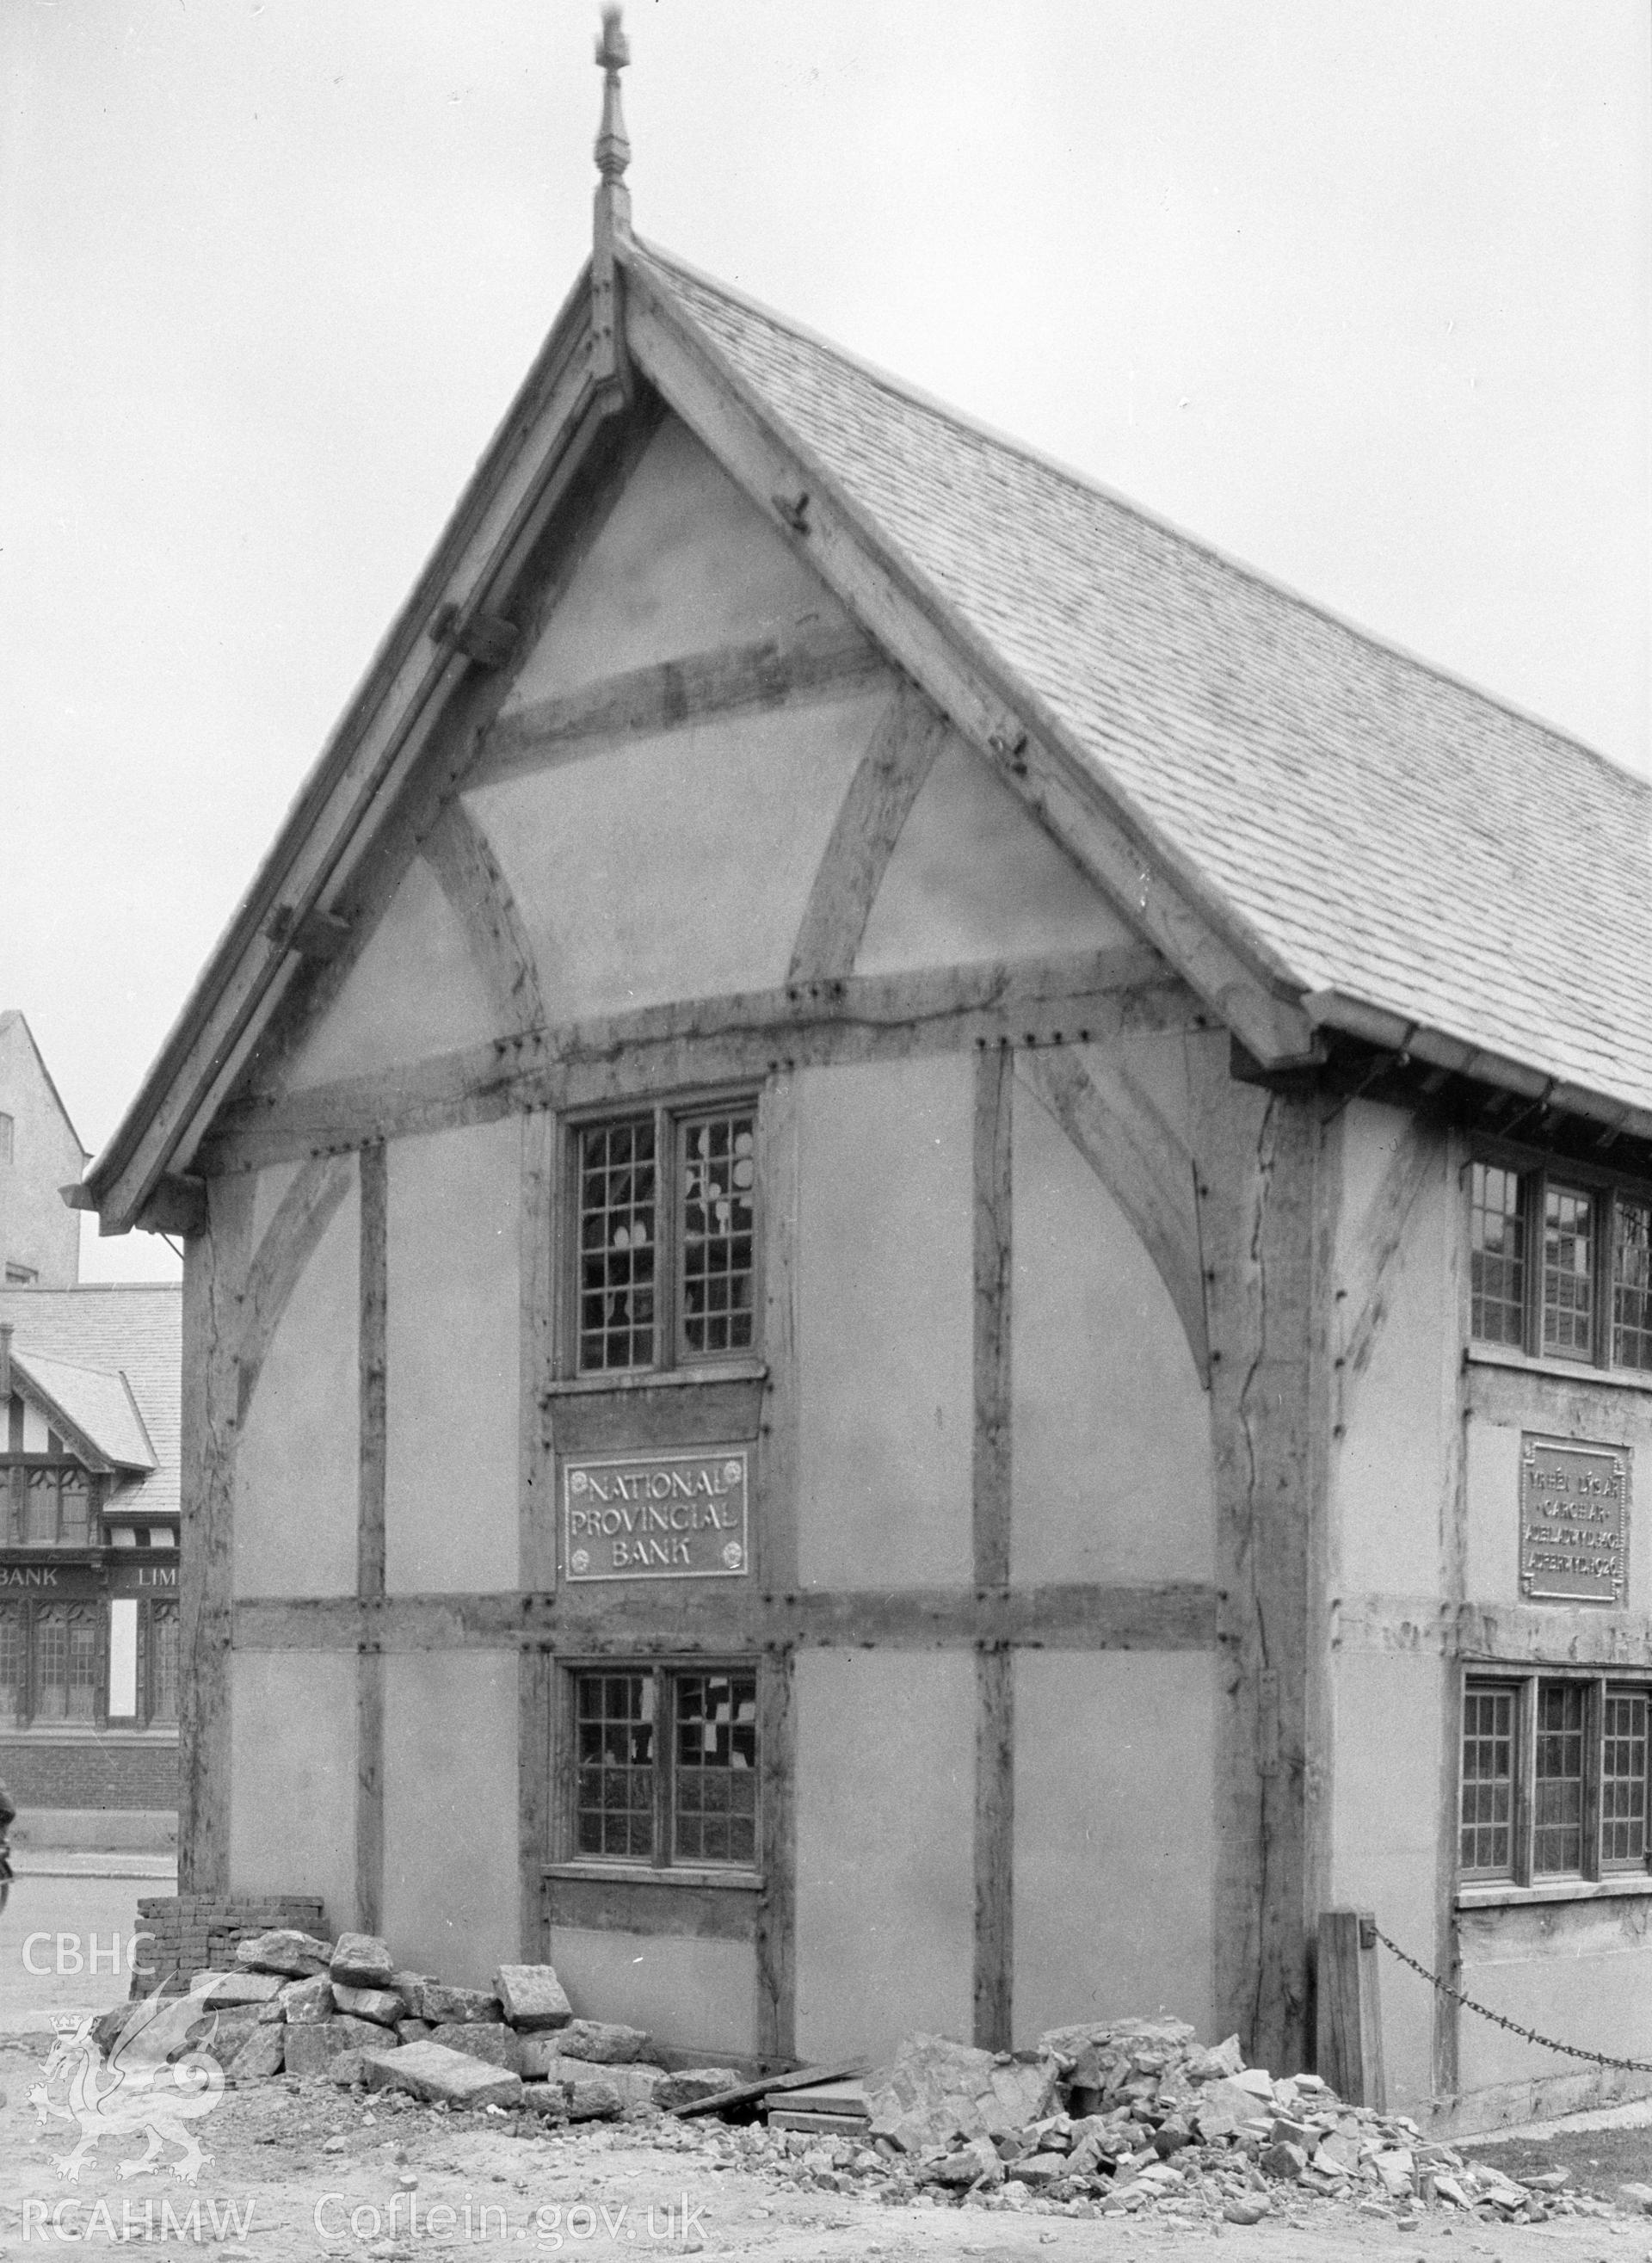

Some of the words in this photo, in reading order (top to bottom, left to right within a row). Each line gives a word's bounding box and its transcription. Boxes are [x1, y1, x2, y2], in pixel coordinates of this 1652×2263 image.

[589, 1471, 728, 1501] NATIONAL
[570, 1503, 738, 1537] PROVINCIAL
[613, 1537, 690, 1567] BANK
[0, 1568, 58, 1587] BANK
[139, 1568, 177, 1587] LIM
